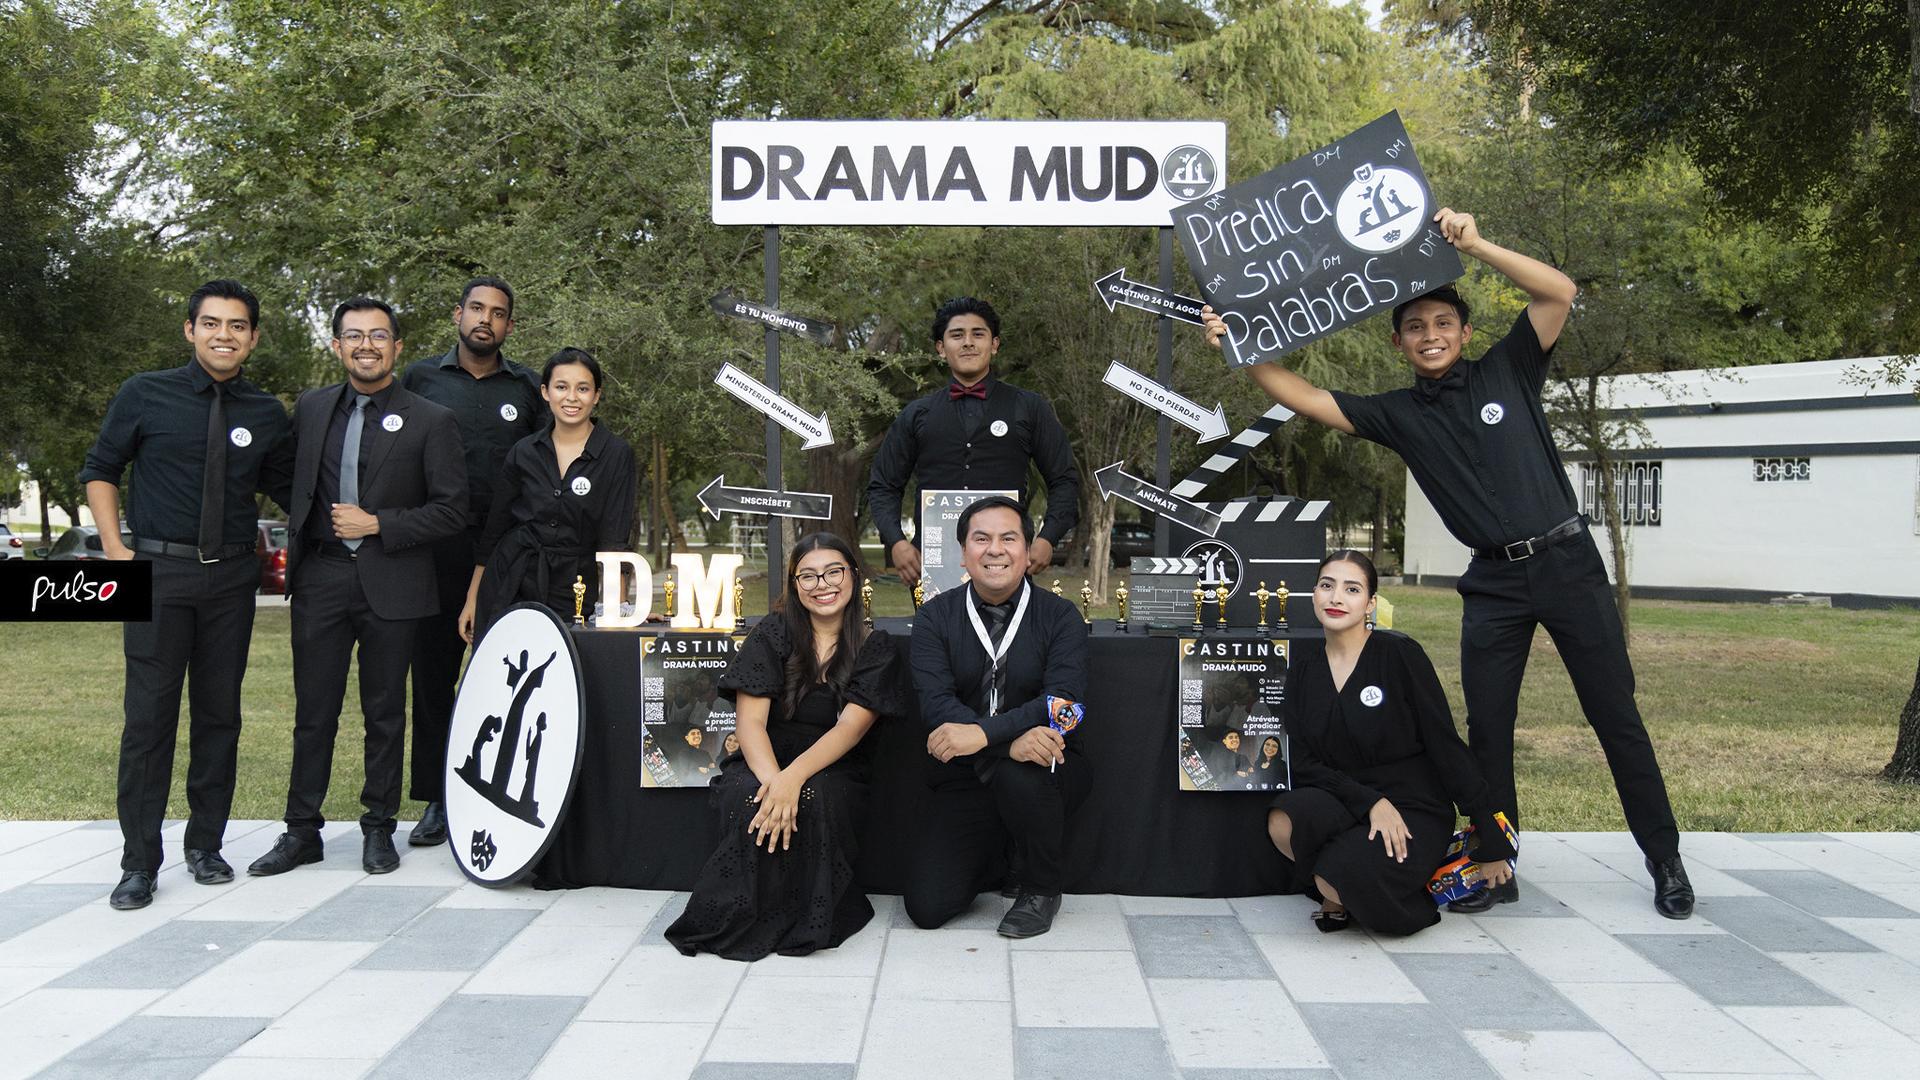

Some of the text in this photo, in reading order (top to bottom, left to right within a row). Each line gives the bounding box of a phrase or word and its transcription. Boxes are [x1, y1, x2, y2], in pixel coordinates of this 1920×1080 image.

[1312, 145, 1340, 167] DM
[1385, 138, 1405, 159] DM
[721, 145, 988, 202] DRAMA
[1204, 193, 1225, 210] DM
[1186, 179, 1333, 266] Predica
[1419, 229, 1441, 257] DM
[1322, 254, 1341, 270] DM
[1205, 273, 1226, 294] DM
[1410, 280, 1426, 293] DM
[1151, 296, 1162, 305] 24
[1163, 299, 1175, 309] DE
[1175, 303, 1203, 317] AGOS
[1220, 257, 1398, 364] Palabras
[735, 303, 807, 331] ES TU MOMENTO
[1246, 352, 1260, 365] DM
[725, 374, 822, 437] MINISTERIO DRAMA MUDO
[1130, 380, 1201, 421] NO TE LO PIERDAS
[740, 496, 792, 508] INSCRÍBETE
[925, 496, 985, 507] CAST
[1136, 489, 1178, 512] ANÍMATE
[942, 512, 962, 520] DRA
[1183, 643, 1286, 657] CASTING
[663, 660, 728, 669] DRAMA MUDO
[1202, 663, 1267, 672] DRAMA MUDO
[708, 711, 736, 719] Atrévet
[711, 718, 736, 727] predic
